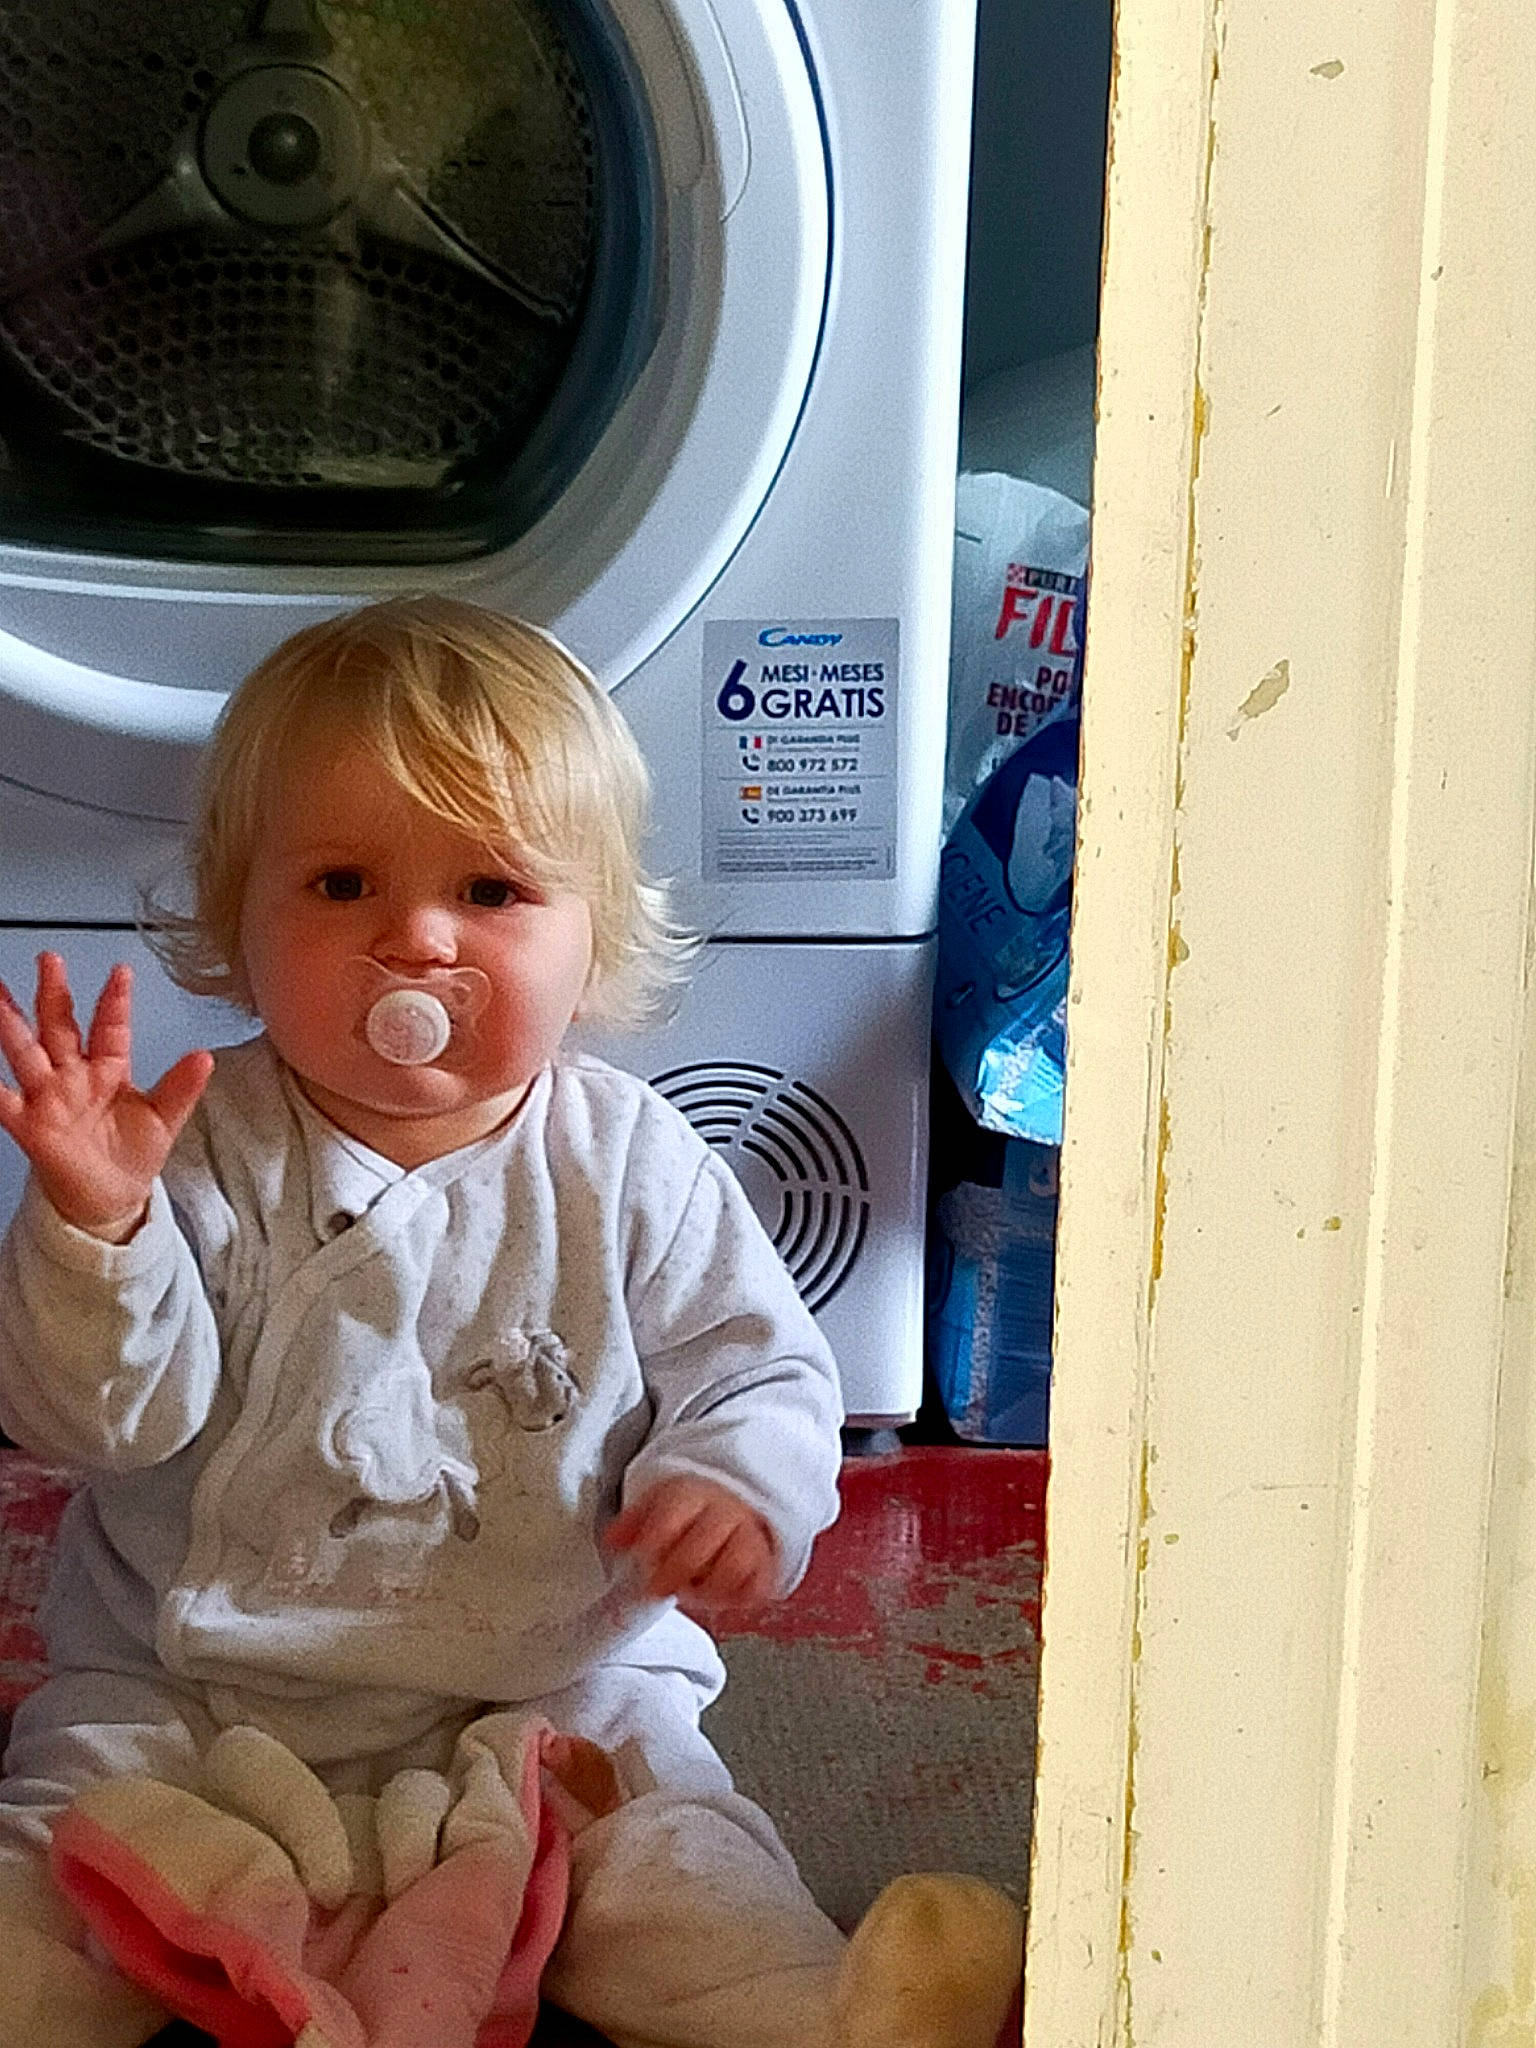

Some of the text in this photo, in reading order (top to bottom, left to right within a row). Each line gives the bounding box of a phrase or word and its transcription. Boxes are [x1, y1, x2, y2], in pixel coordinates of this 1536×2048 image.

[717, 658, 756, 721] 6
[760, 687, 885, 719] GRATIS
[996, 712, 1027, 737] DE
[766, 758, 795, 772] 800
